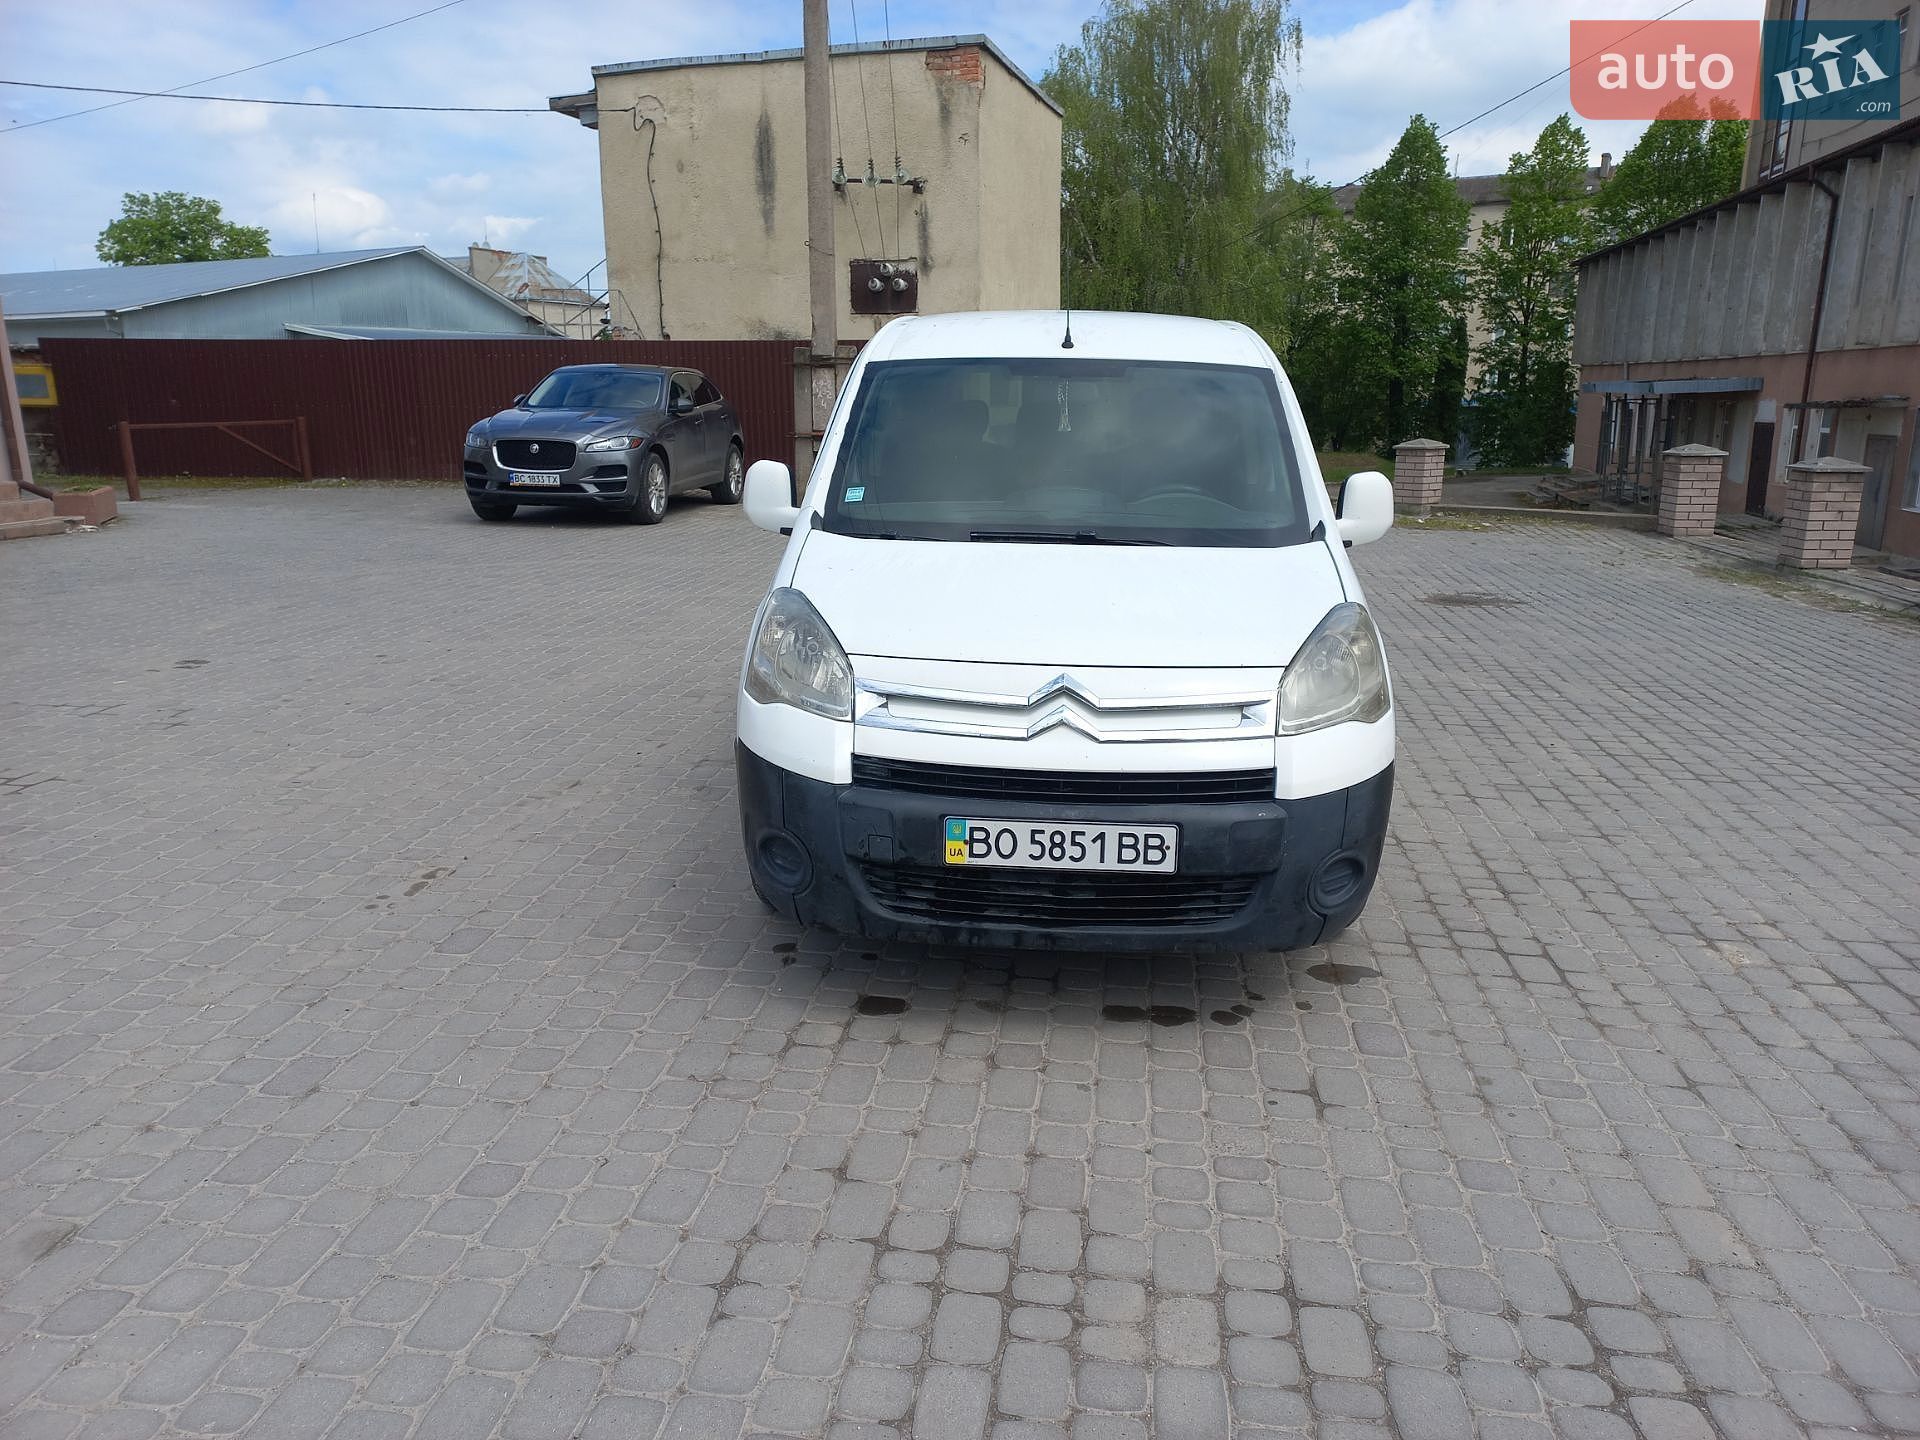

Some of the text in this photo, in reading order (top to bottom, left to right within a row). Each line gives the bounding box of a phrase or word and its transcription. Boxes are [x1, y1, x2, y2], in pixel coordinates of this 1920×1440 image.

[514, 474, 526, 483] BC
[546, 475, 558, 484] TX
[968, 826, 1167, 865] BO 5851 BB
[949, 848, 964, 857] UA
